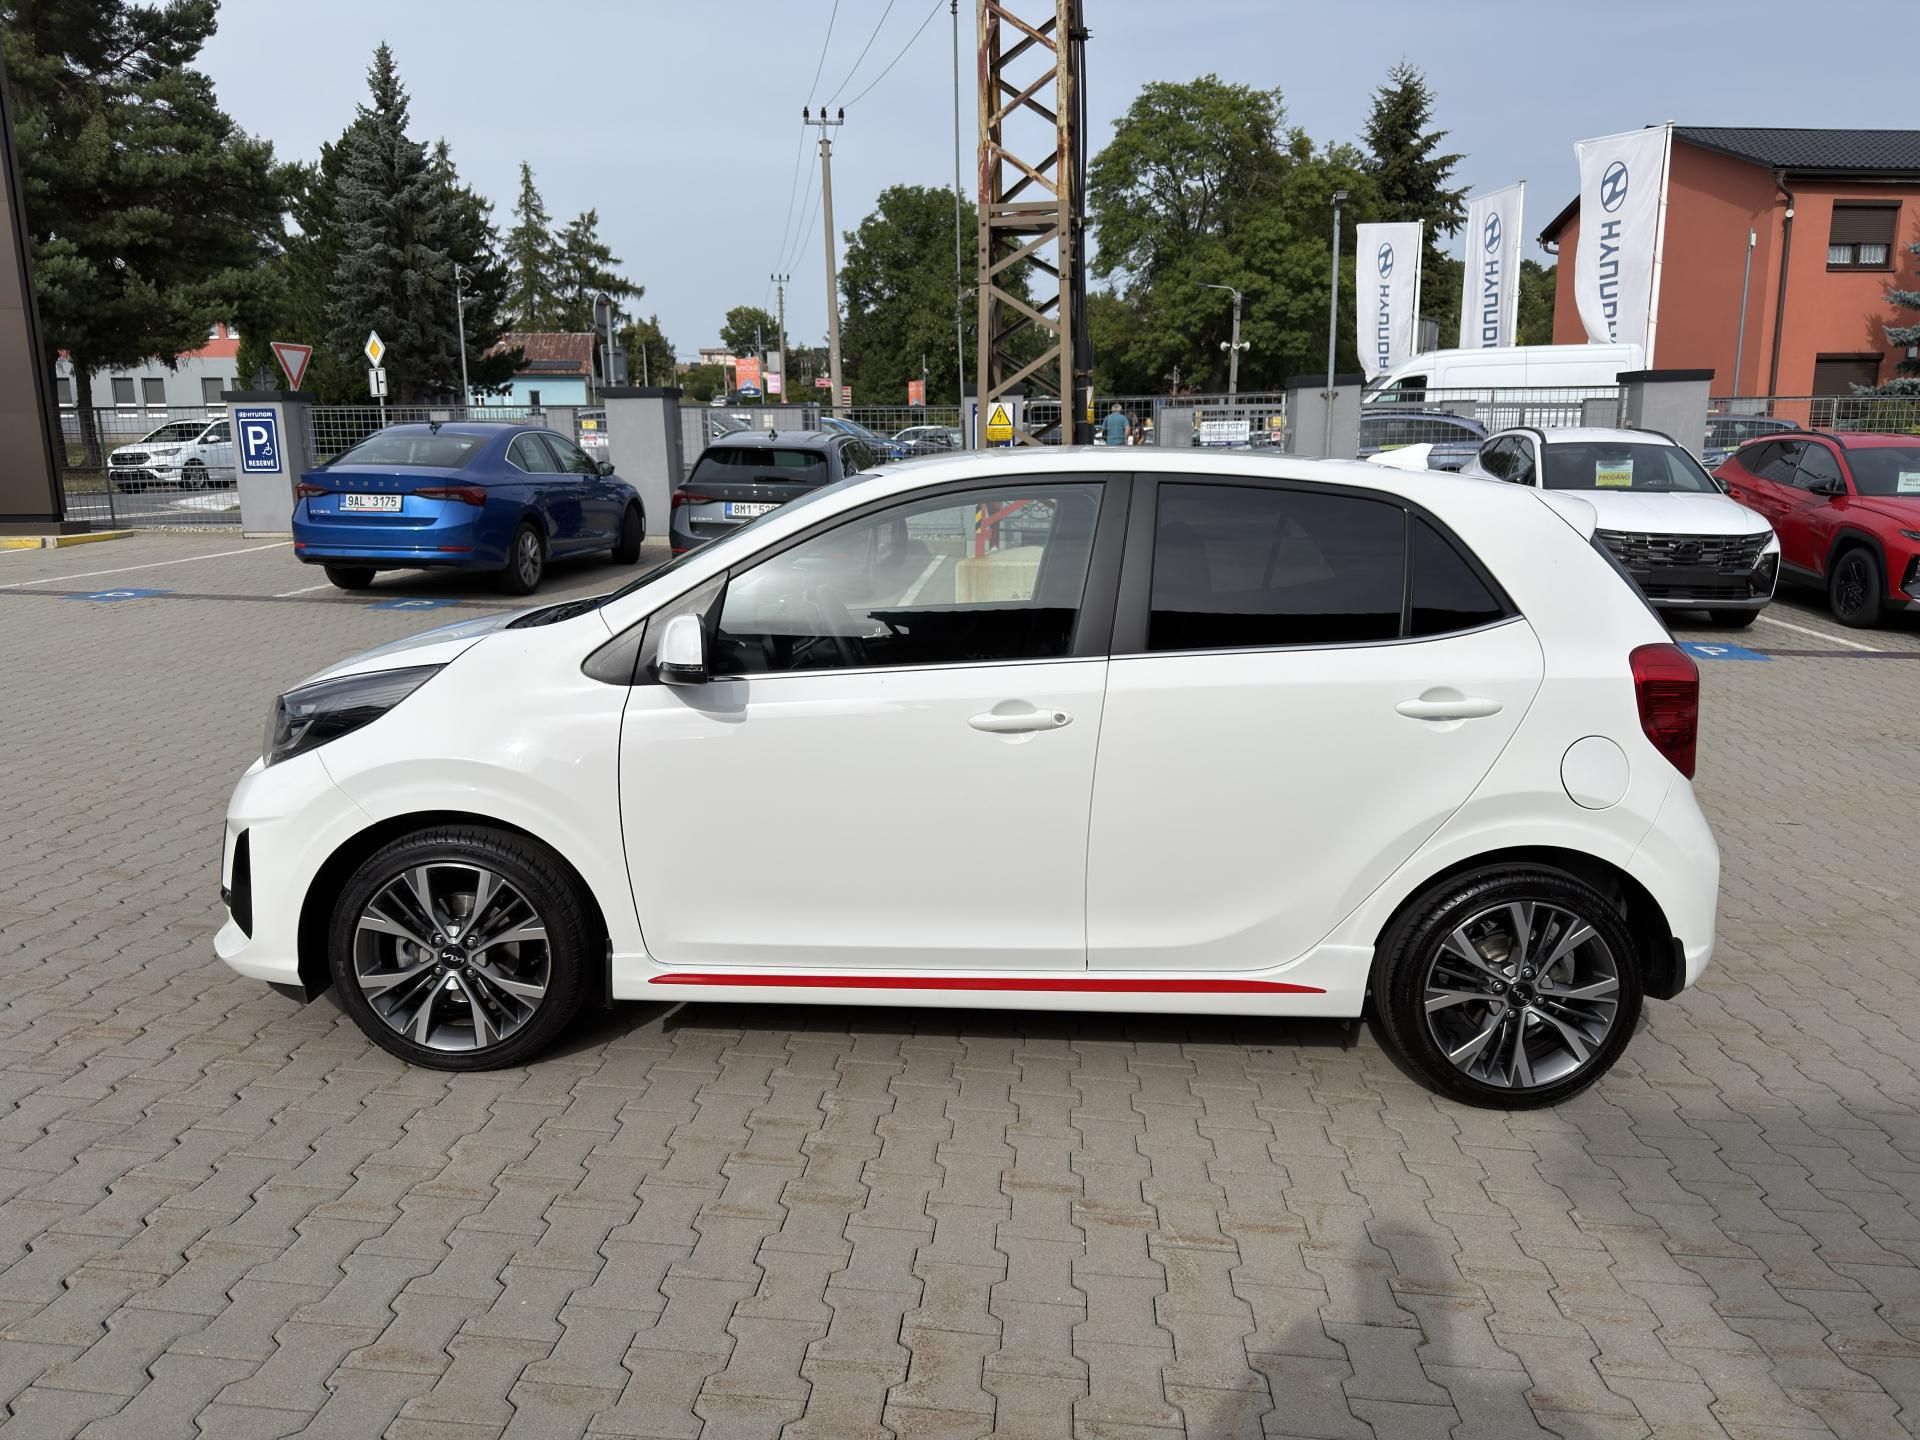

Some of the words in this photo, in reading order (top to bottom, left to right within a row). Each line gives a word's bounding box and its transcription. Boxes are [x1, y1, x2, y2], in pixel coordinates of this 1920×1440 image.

[247, 426, 268, 456] P
[347, 495, 366, 507] 9AL
[372, 496, 397, 507] 3175
[734, 504, 752, 515] 8M1
